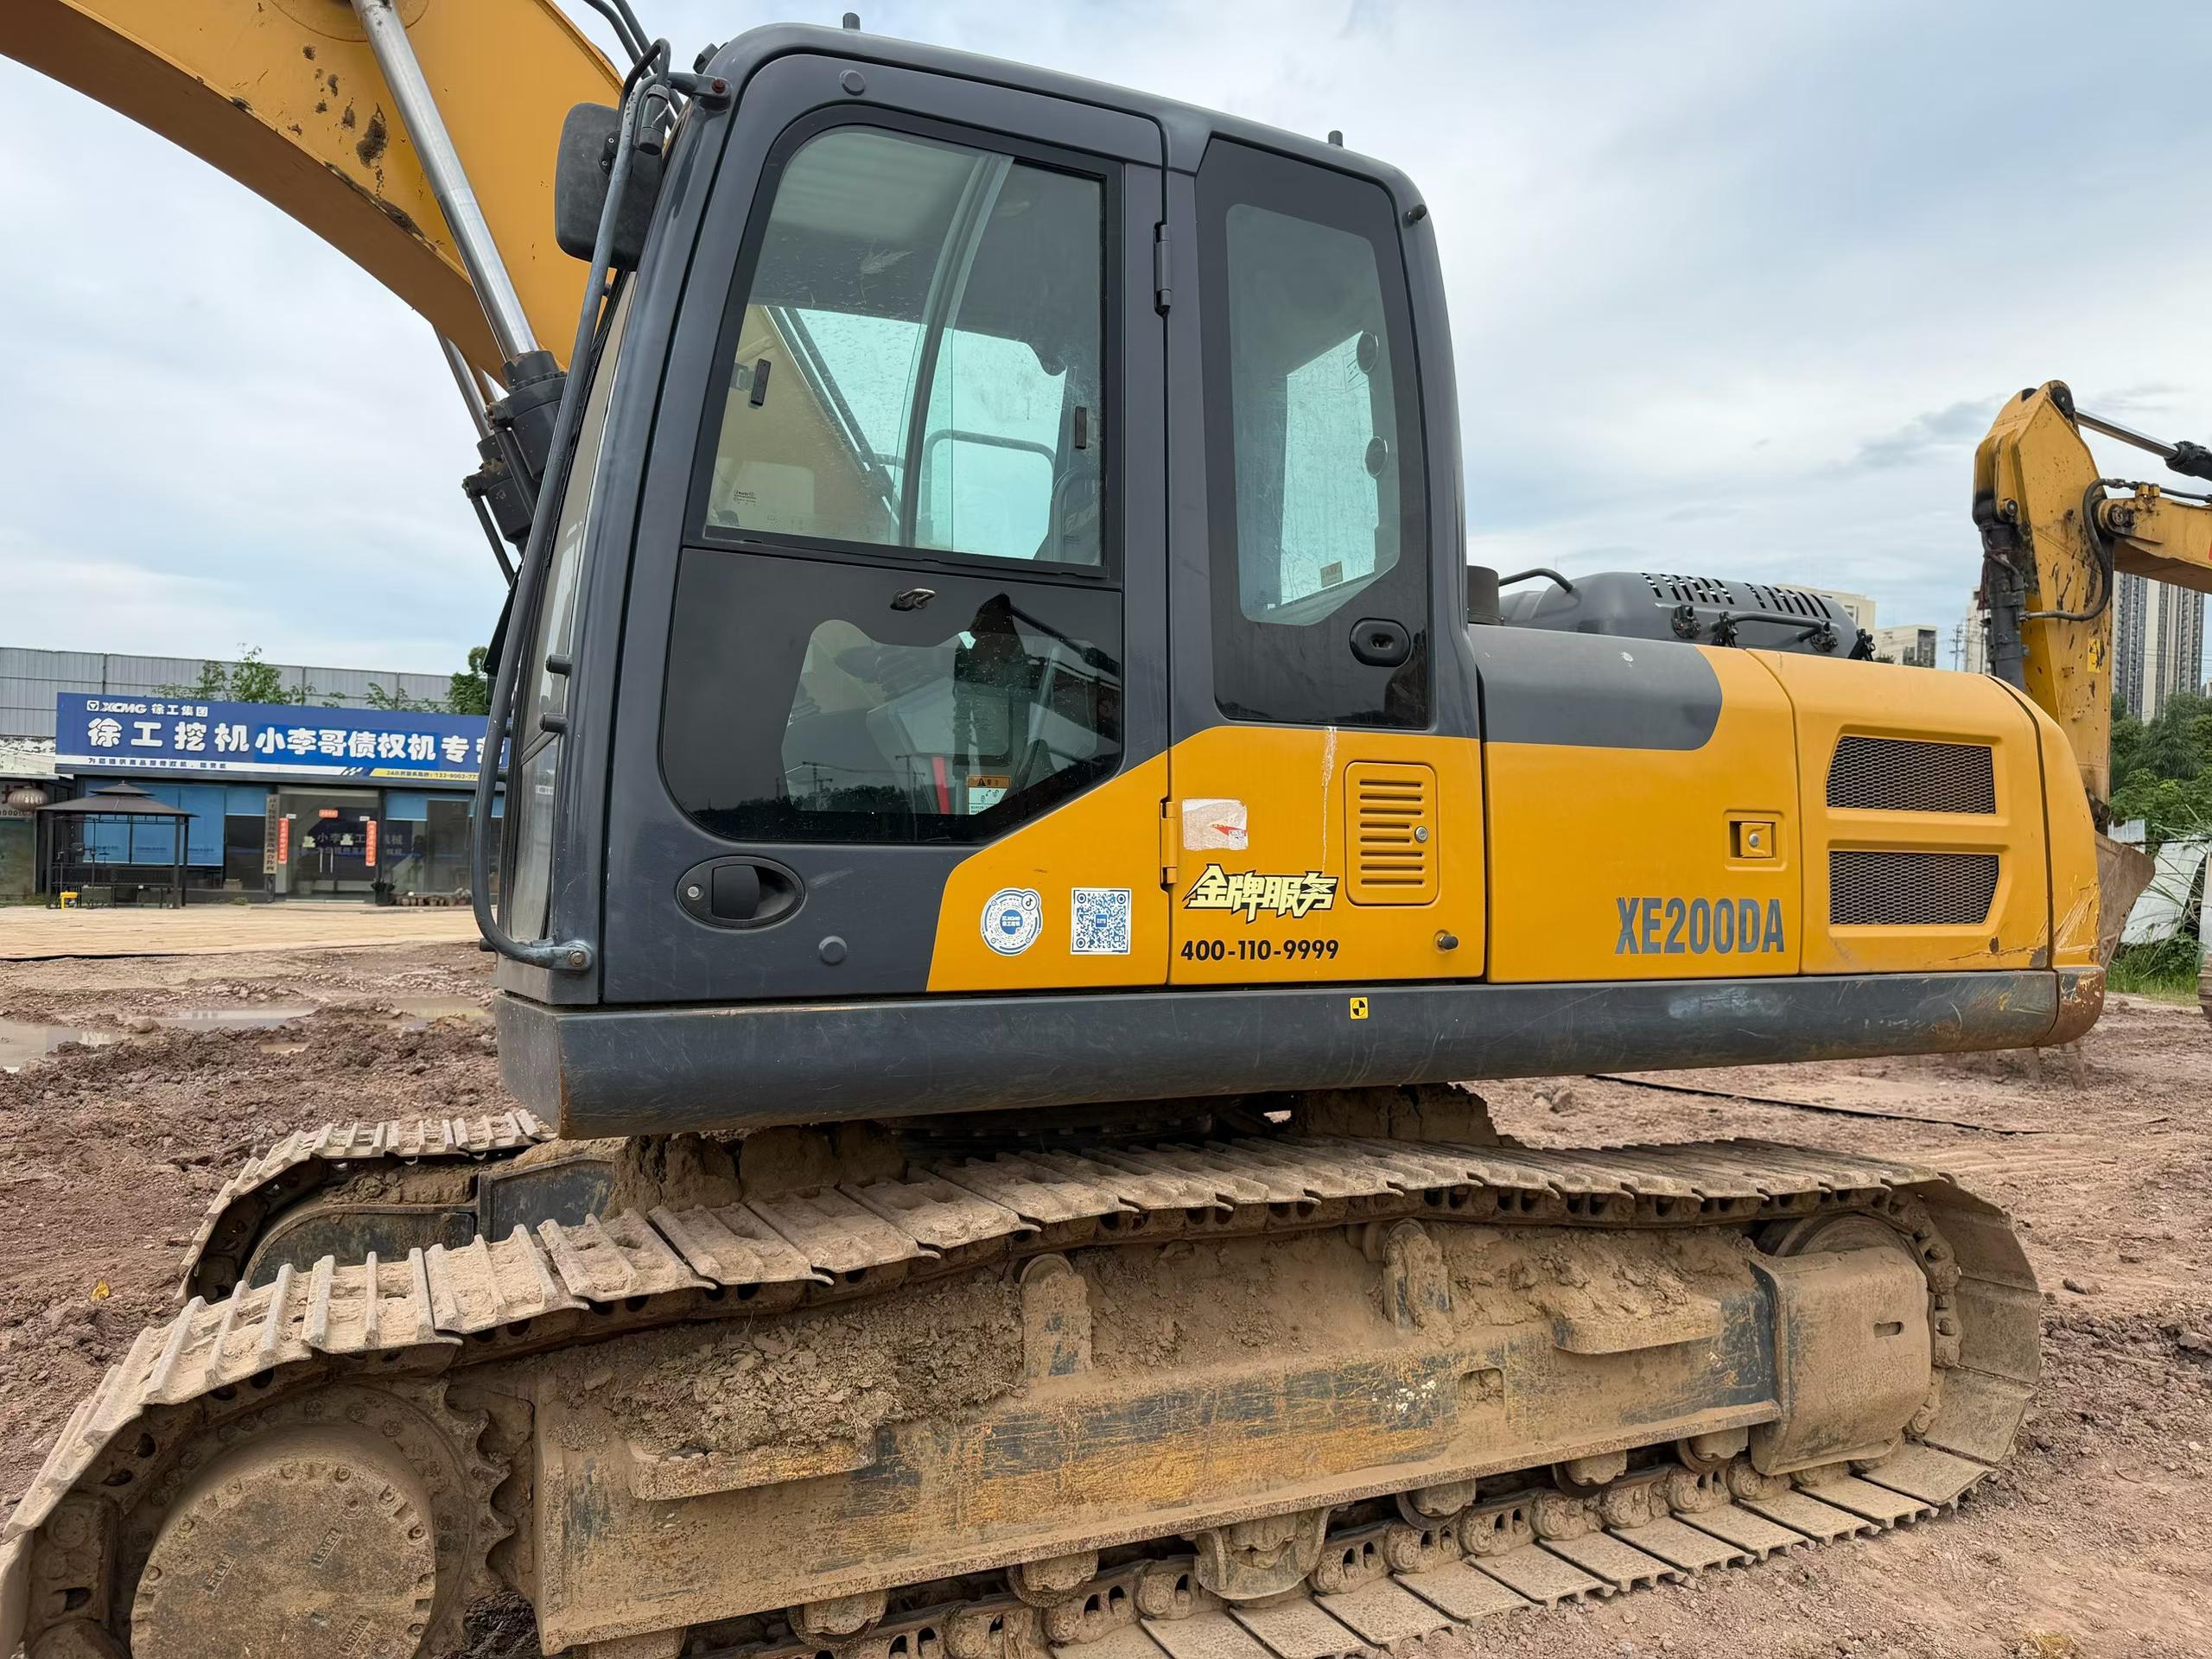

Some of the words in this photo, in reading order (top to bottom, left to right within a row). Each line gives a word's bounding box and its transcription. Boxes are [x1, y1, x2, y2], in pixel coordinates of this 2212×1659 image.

[99, 702, 147, 715] XCMG
[151, 702, 208, 718] 徐工集团
[1183, 863, 1338, 925] 金牌服务
[1614, 897, 1784, 955] XE200DA
[1180, 939, 1339, 961] 400-110-9999
[312, 1527, 342, 1565] LEVEL
[340, 1615, 372, 1654] DRAIN
